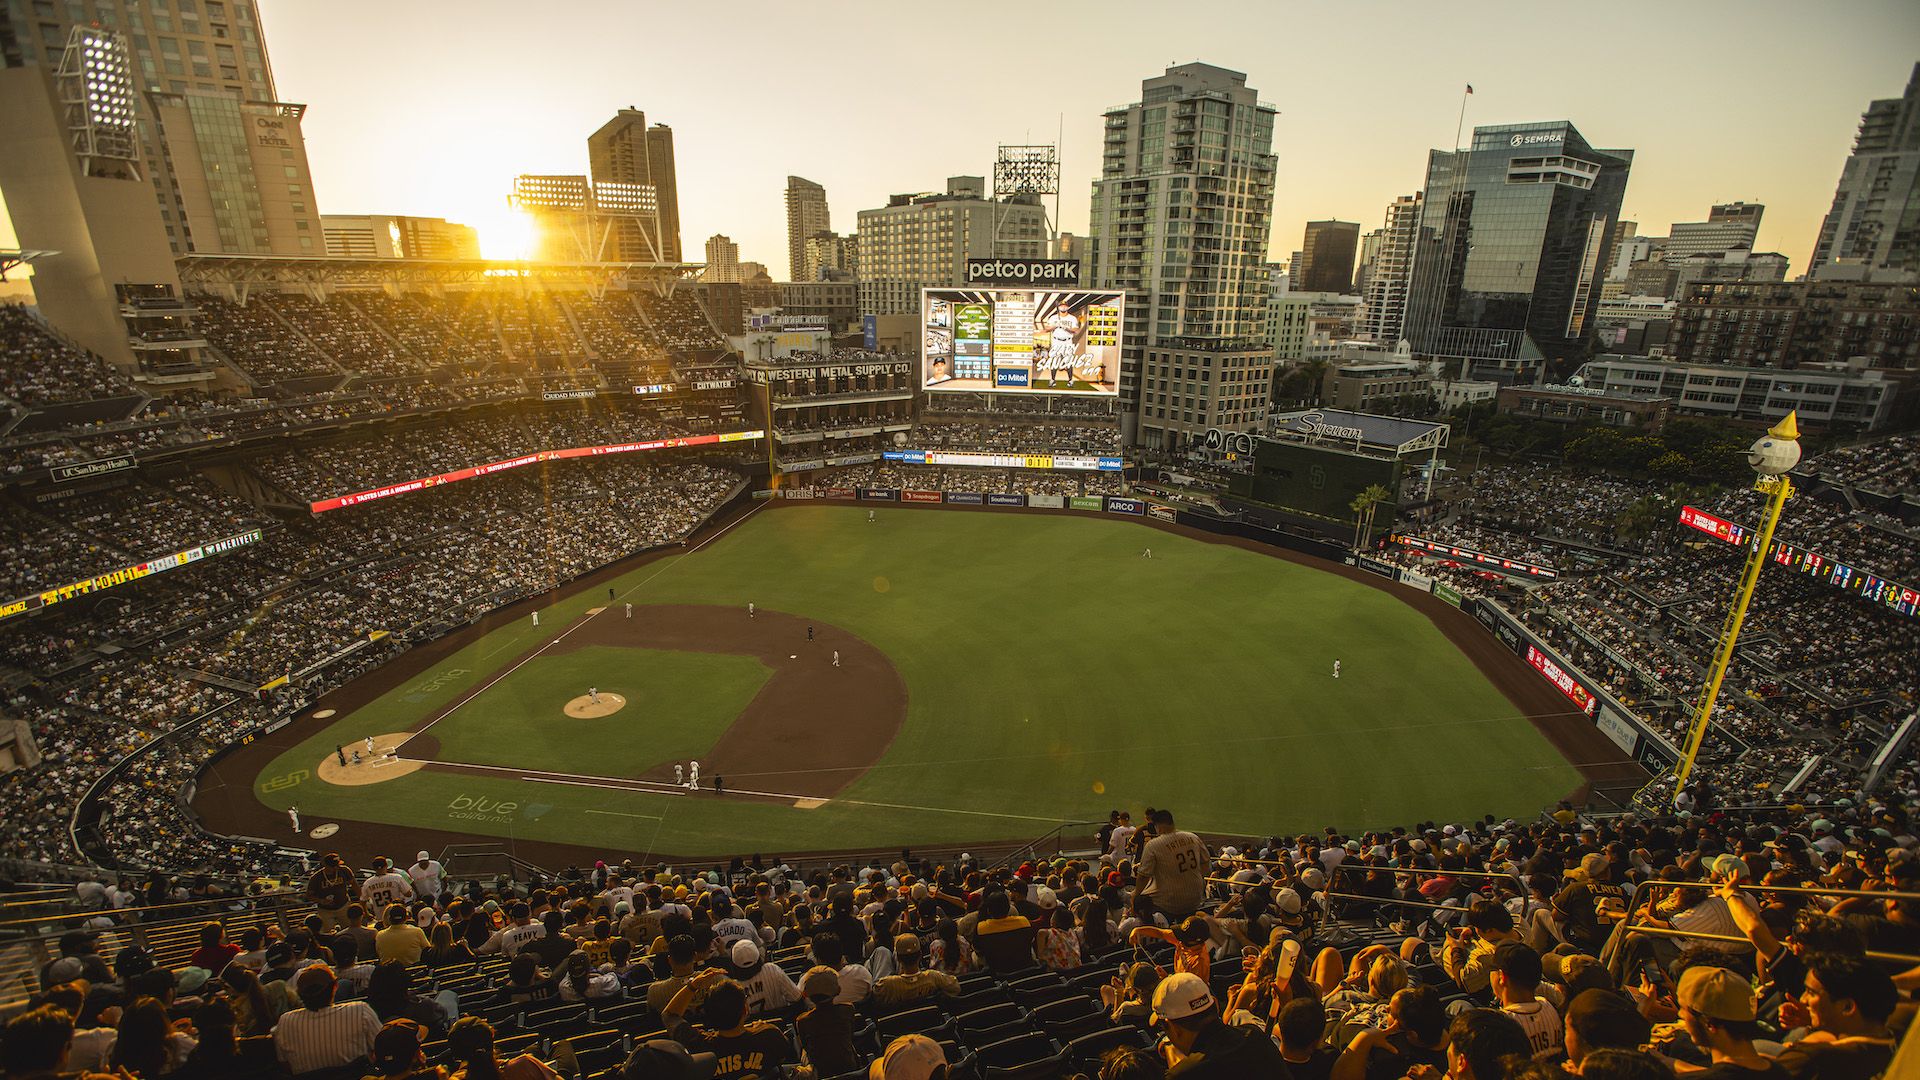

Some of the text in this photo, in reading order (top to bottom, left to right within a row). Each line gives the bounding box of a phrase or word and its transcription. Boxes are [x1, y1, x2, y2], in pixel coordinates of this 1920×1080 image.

[1524, 134, 1562, 144] SEMPRA
[969, 260, 1077, 282] petco park
[768, 363, 911, 381] WESTERN METAL SUPPLY CO.
[1008, 374, 1027, 382] Mitel
[697, 381, 731, 390] CUTWATER
[1296, 412, 1363, 440] Sycuan
[62, 468, 74, 478] UC
[107, 459, 129, 469] Health
[991, 496, 1018, 504] Southwest
[1110, 501, 1135, 512] ARCO
[448, 793, 518, 814] blue
[448, 811, 514, 824] california
[1176, 849, 1198, 873] 23
[373, 889, 393, 907] 23
[513, 930, 538, 943] PEAVY
